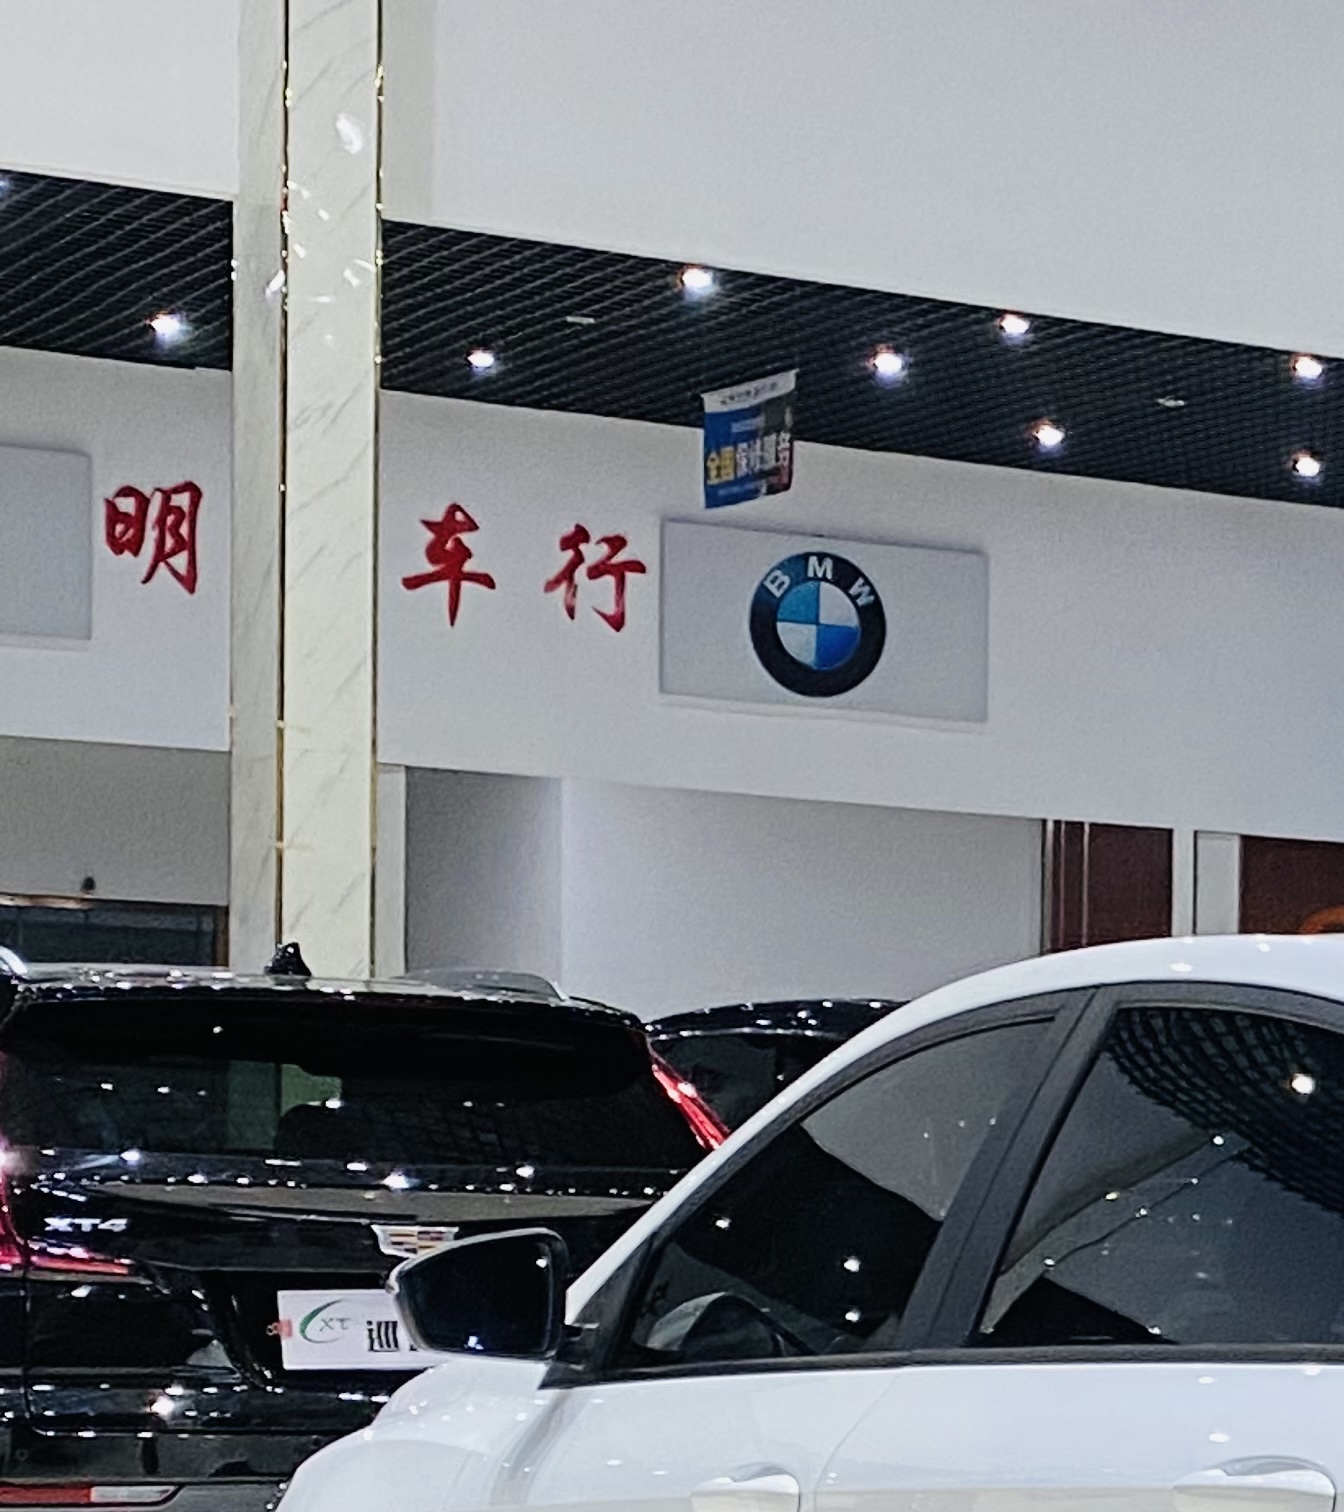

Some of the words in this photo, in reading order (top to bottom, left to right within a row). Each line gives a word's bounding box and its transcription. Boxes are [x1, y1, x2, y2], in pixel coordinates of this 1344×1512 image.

[104, 480, 203, 595] 明
[401, 503, 647, 633] 车行
[763, 556, 875, 607] BMW
